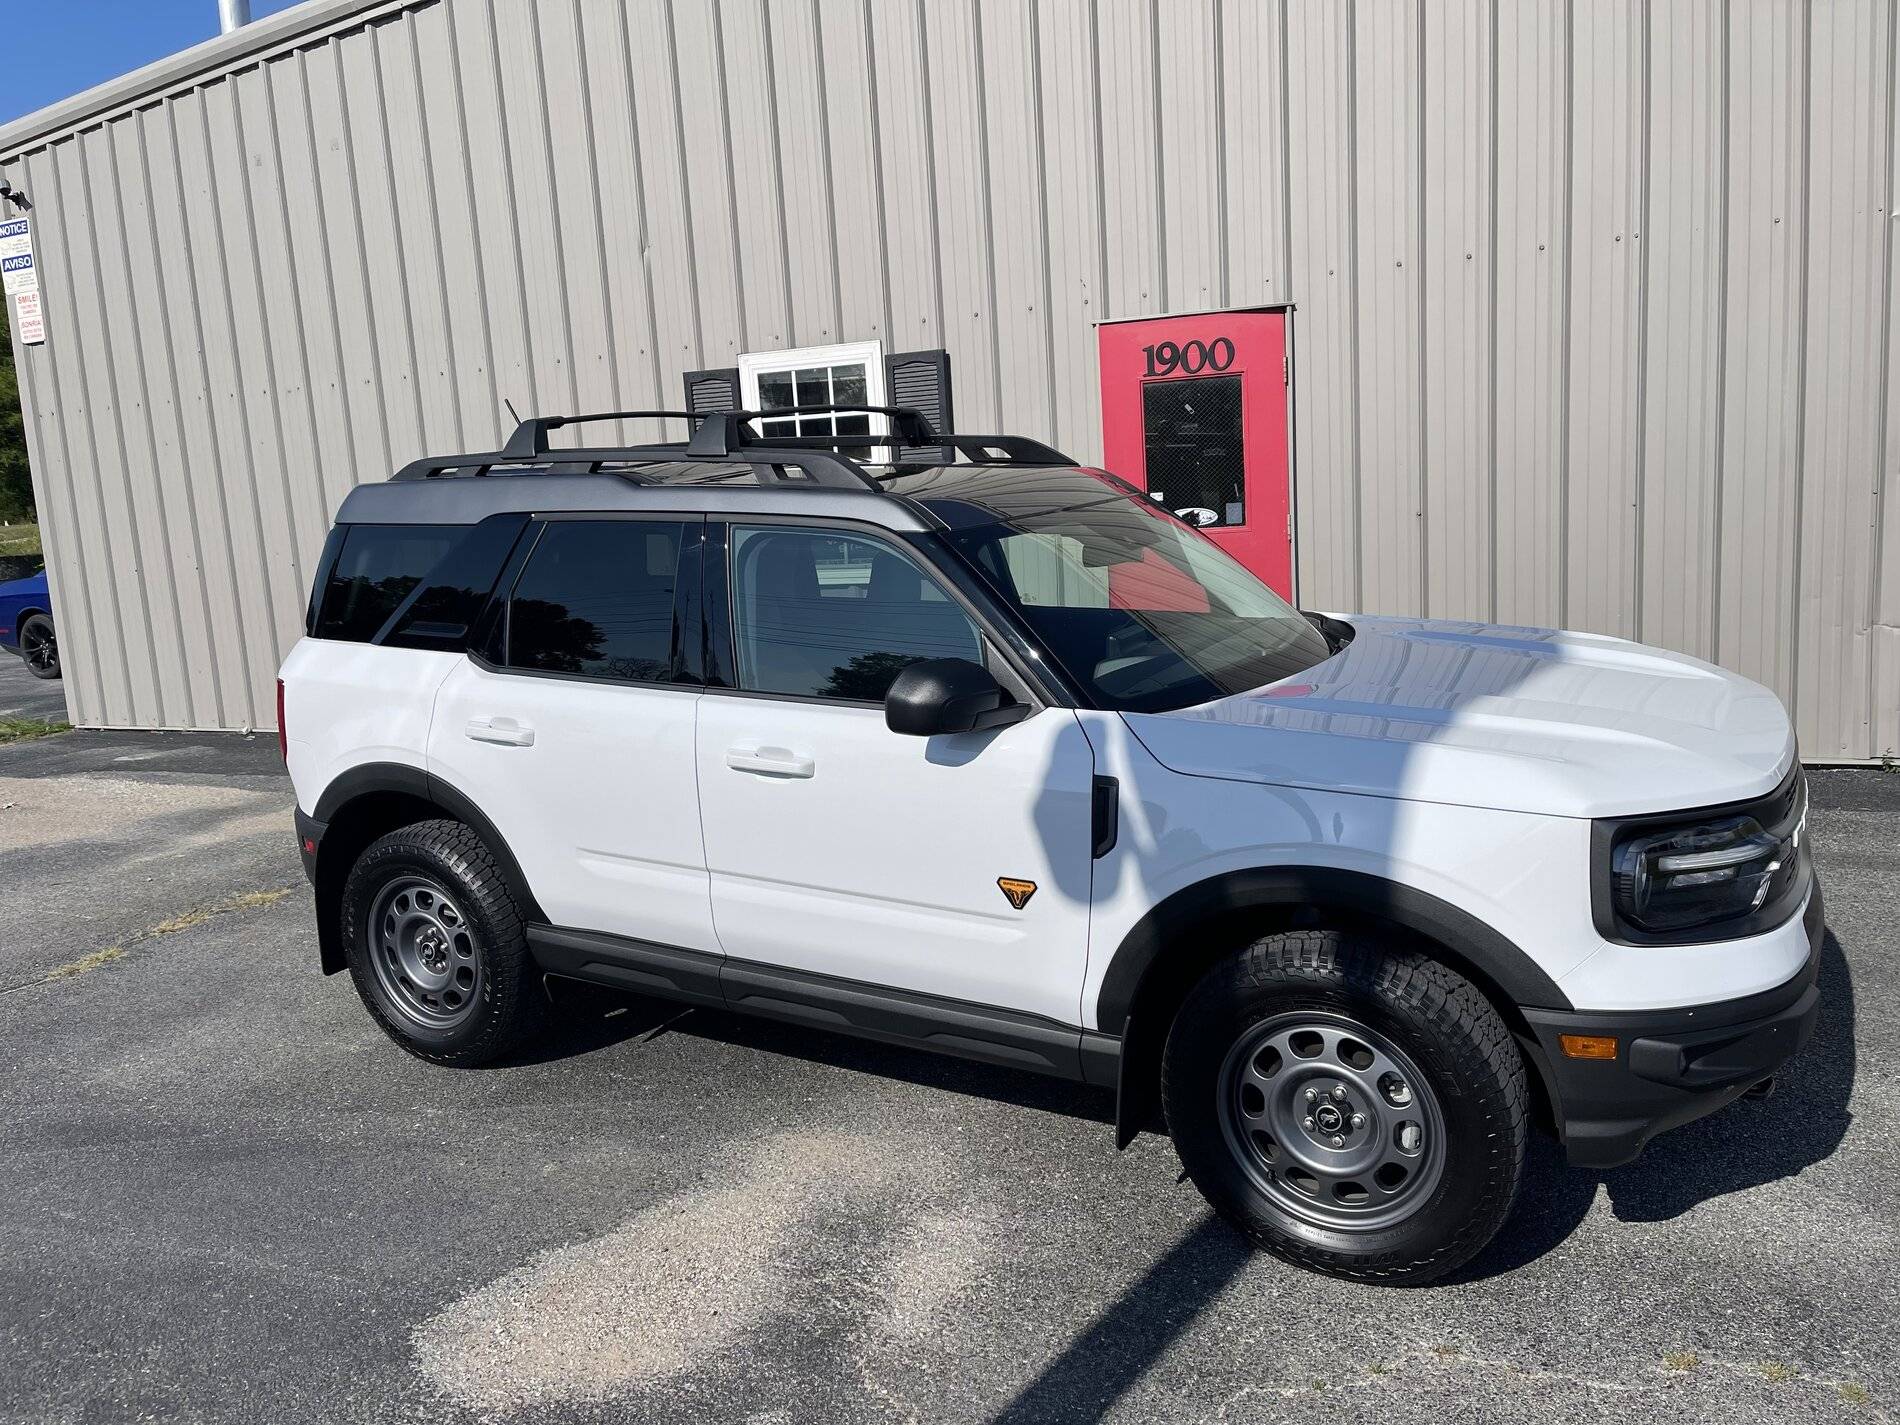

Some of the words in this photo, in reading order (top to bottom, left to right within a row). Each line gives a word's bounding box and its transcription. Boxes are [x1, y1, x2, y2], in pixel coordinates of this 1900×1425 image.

[0, 222, 28, 236] NOTICE
[4, 256, 31, 271] AVISO
[1142, 337, 1235, 377] 1900
